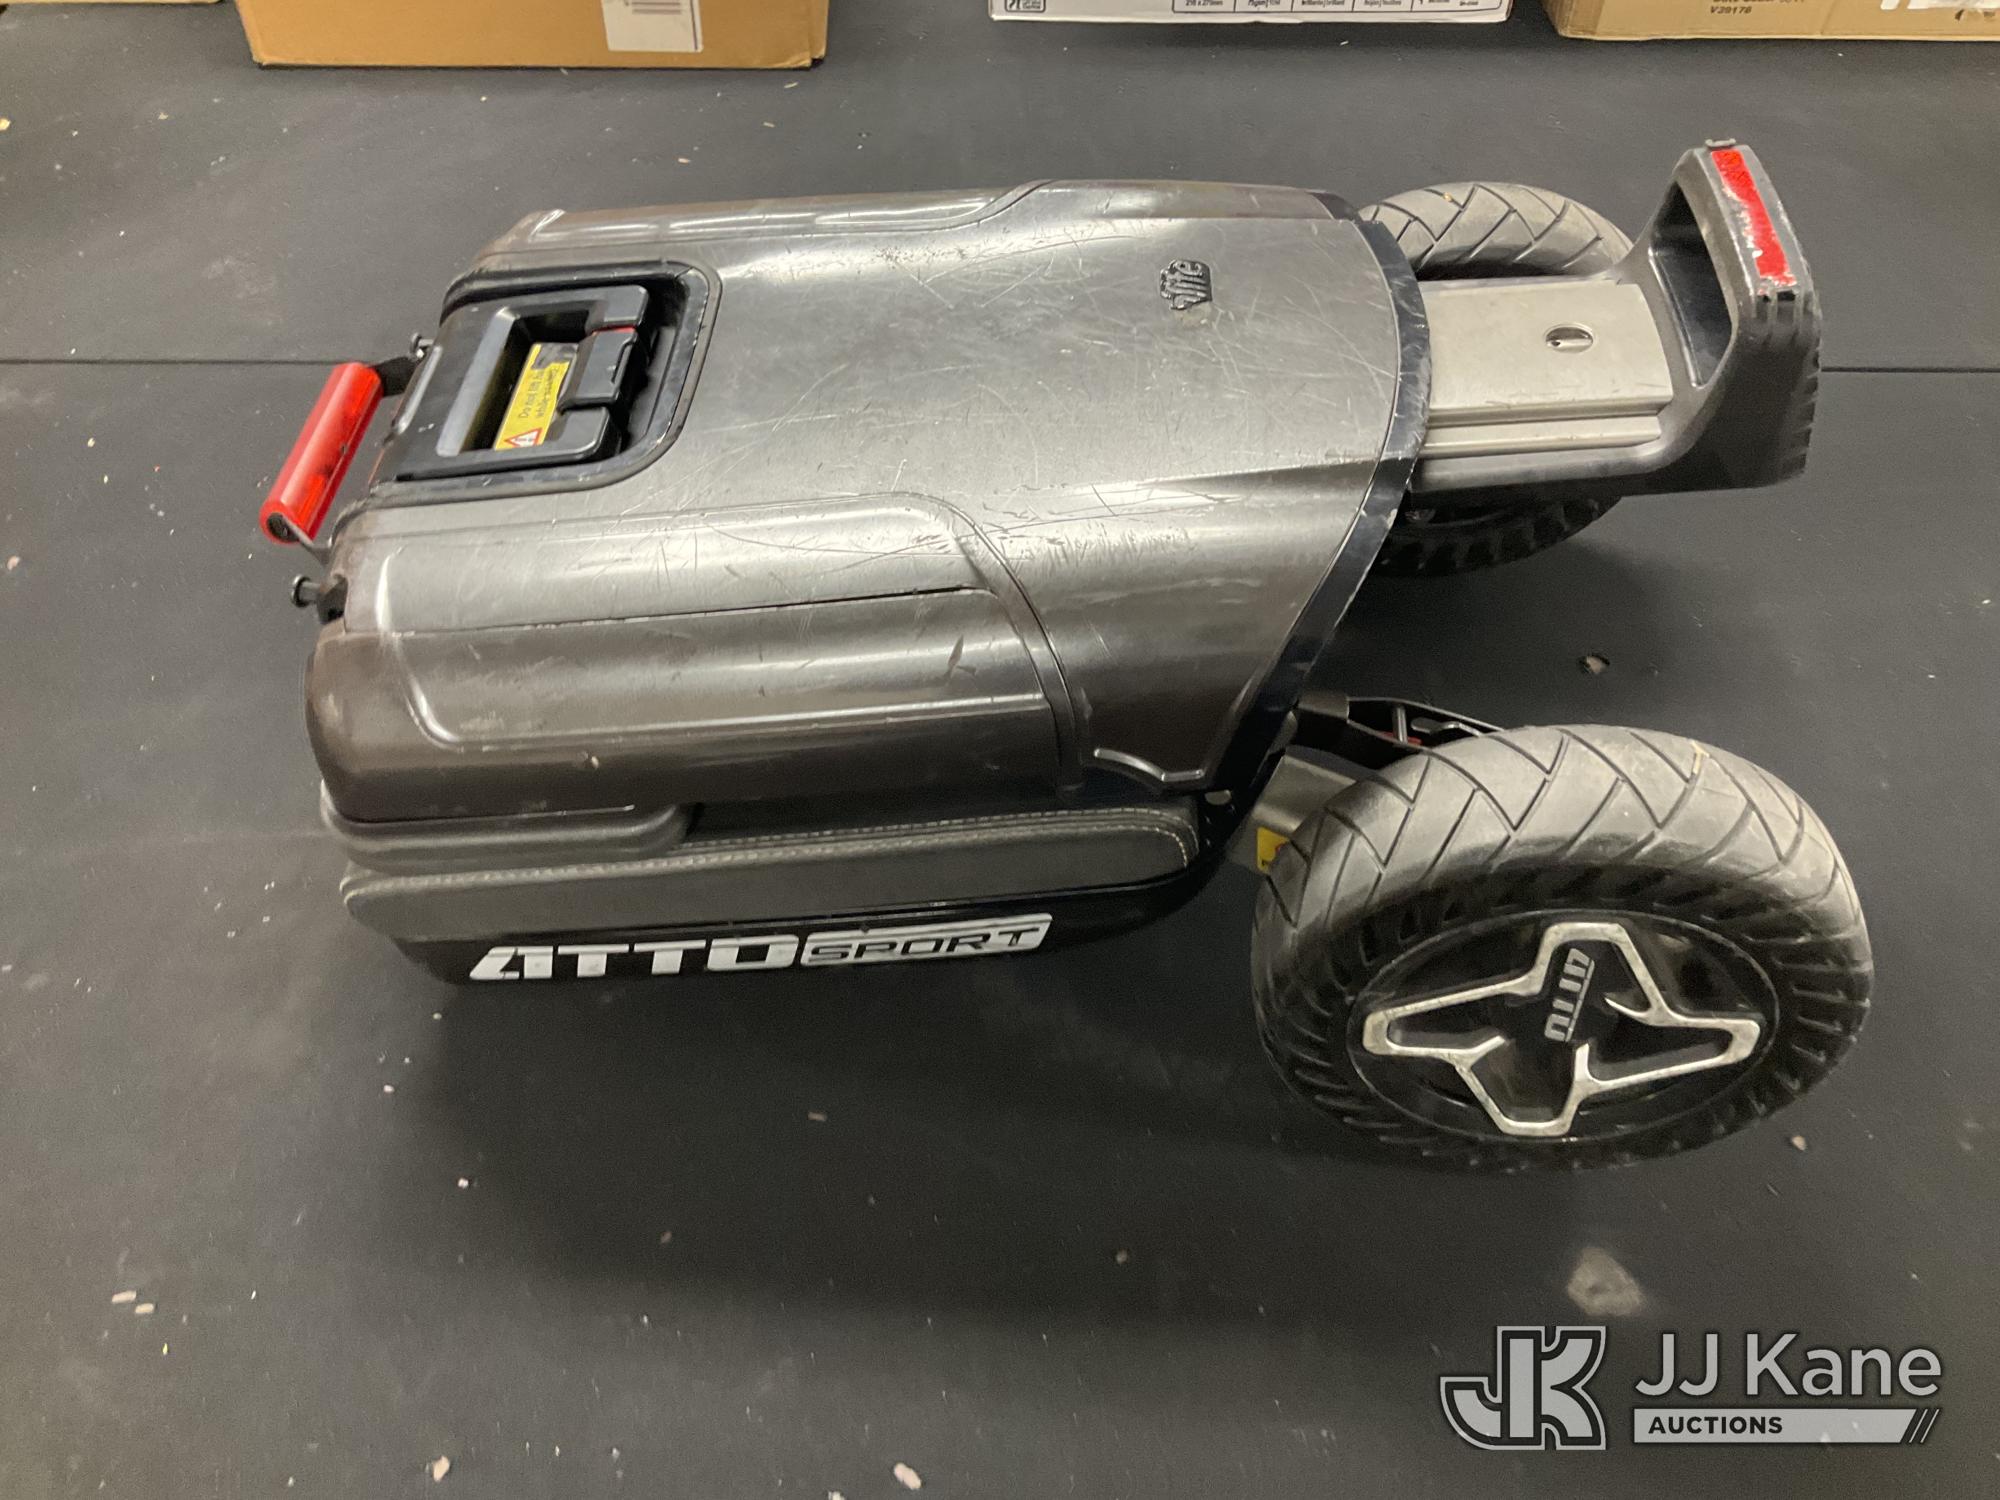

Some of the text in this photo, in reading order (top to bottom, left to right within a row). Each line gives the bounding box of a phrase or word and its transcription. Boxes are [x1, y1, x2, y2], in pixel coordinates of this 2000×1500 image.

[469, 926, 1041, 980] ATTO SPORT
[1545, 948, 1594, 1041] ATTO
